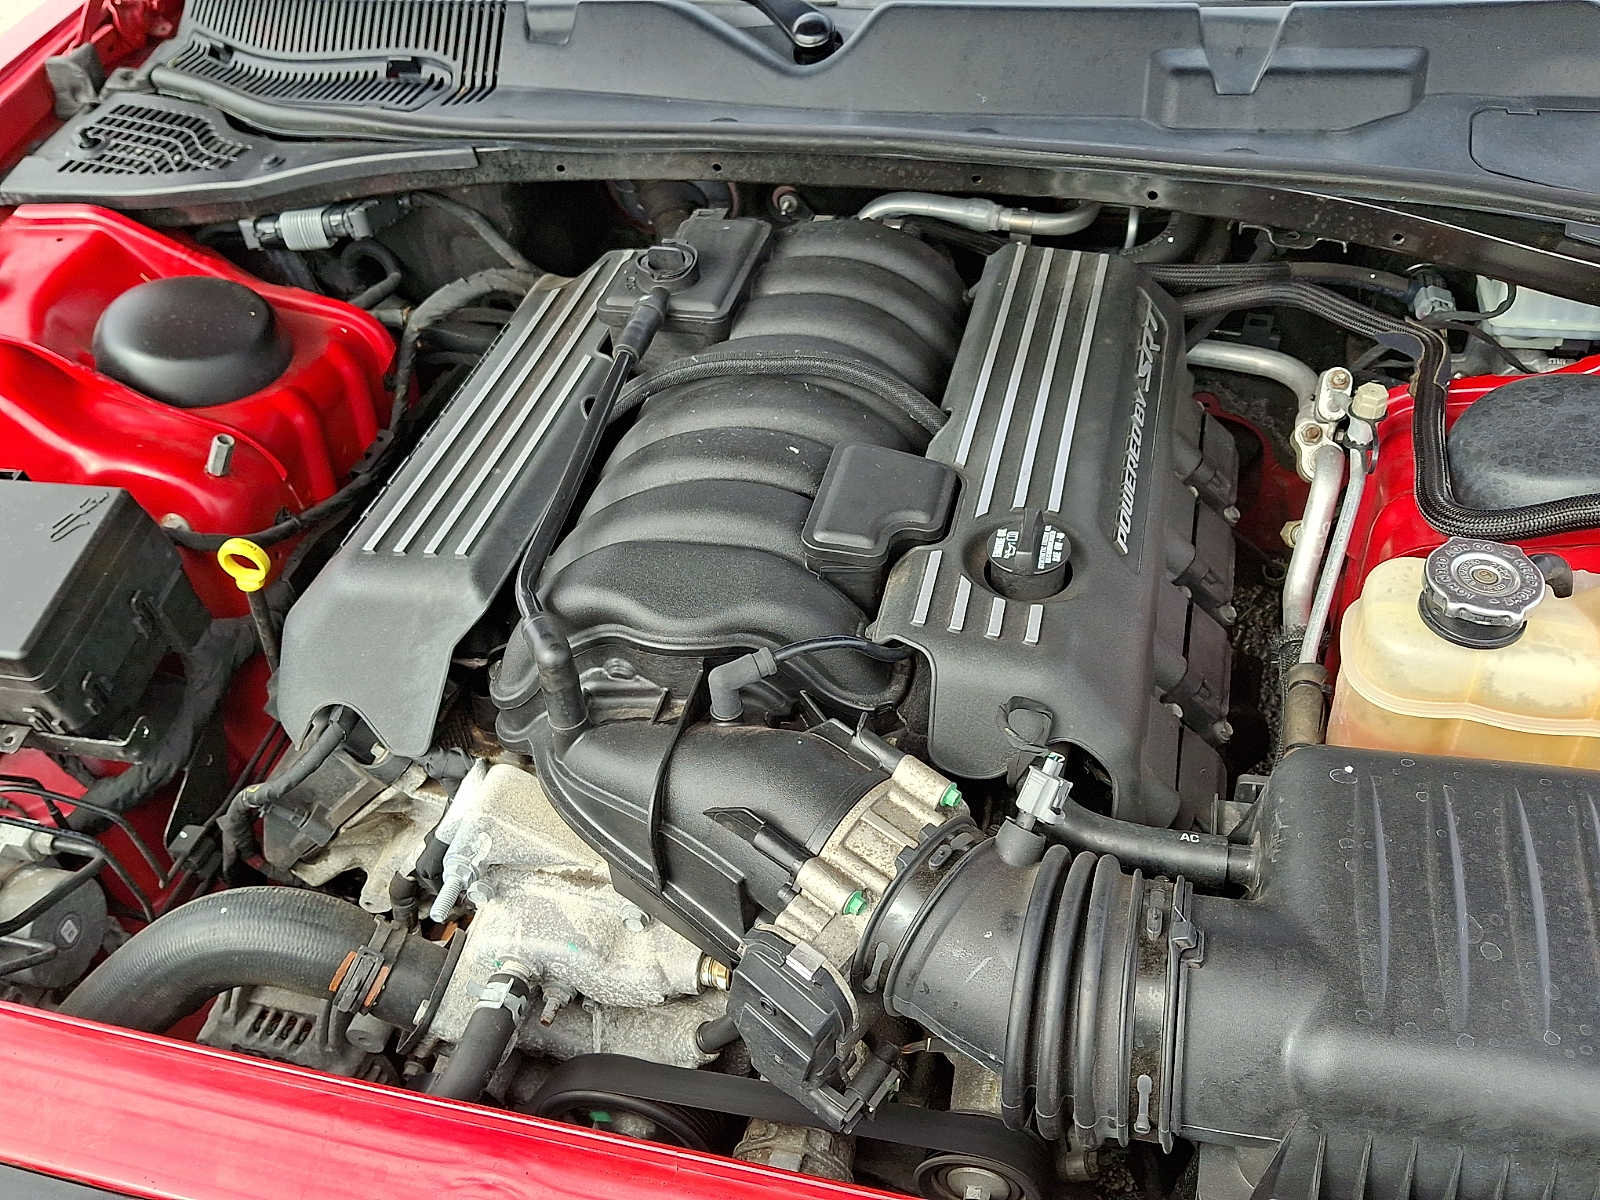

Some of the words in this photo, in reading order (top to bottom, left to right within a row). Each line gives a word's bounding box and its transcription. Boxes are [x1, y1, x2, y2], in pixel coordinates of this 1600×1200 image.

[1137, 300, 1161, 393] SRT
[1132, 387, 1148, 428] BY
[1115, 423, 1144, 555] POWERED
[1434, 556, 1451, 584] OPEN
[1179, 832, 1200, 843] AC
